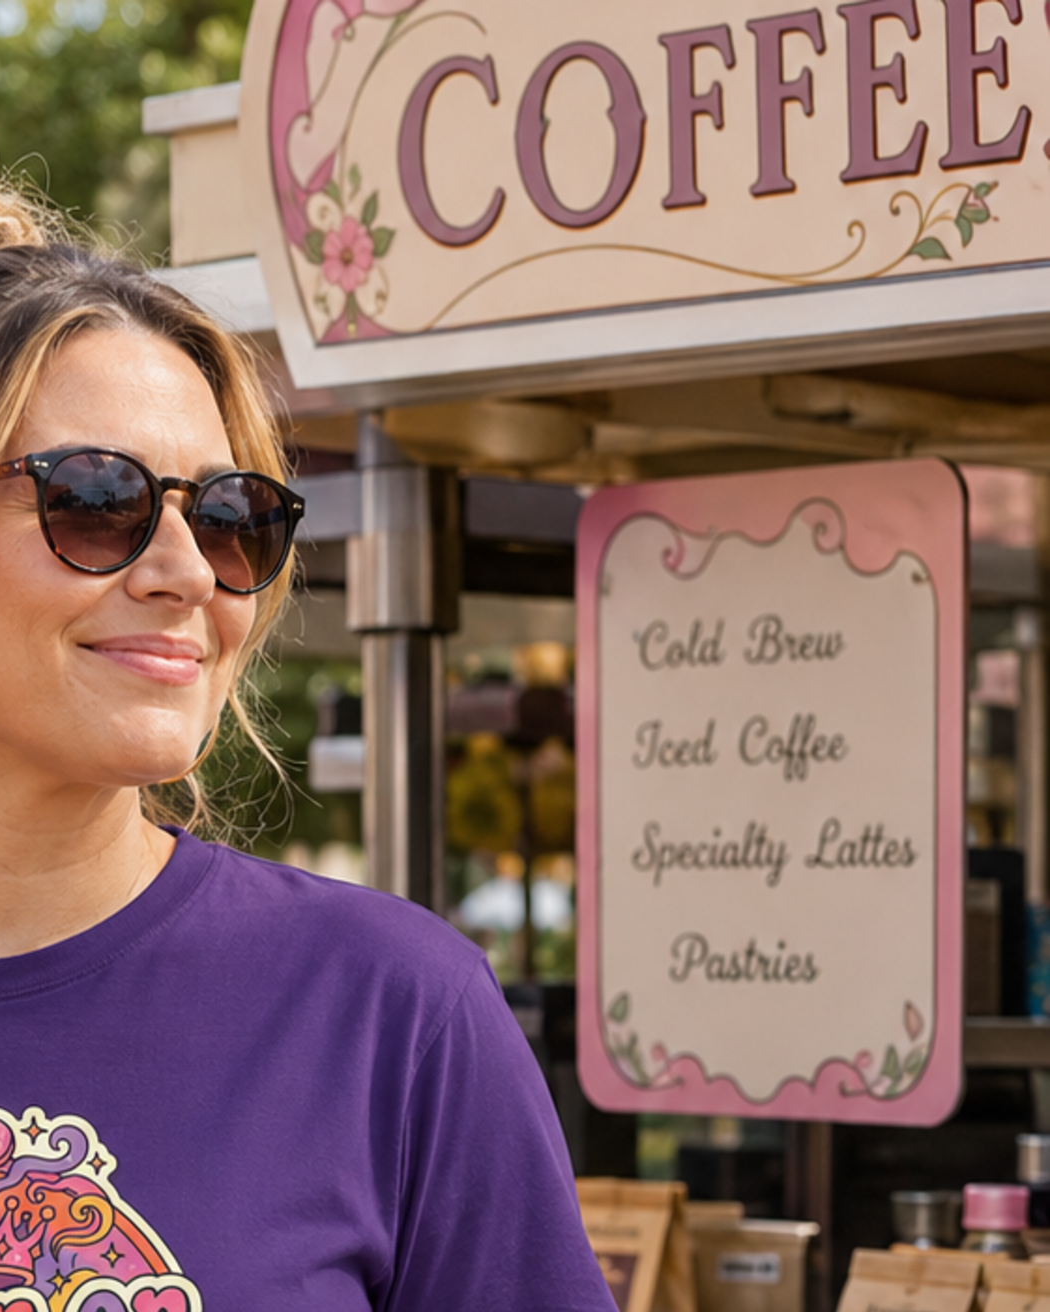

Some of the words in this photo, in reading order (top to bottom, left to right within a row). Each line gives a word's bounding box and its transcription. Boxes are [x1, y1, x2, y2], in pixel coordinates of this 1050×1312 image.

[397, 0, 1032, 249] COFFEE
[632, 619, 724, 671] Cold
[743, 613, 844, 665] Brew
[633, 718, 717, 769] Iced
[738, 713, 846, 783] Coffee
[631, 820, 788, 888] Specialty
[804, 817, 918, 870] Lattes
[668, 931, 820, 985] Pastries
